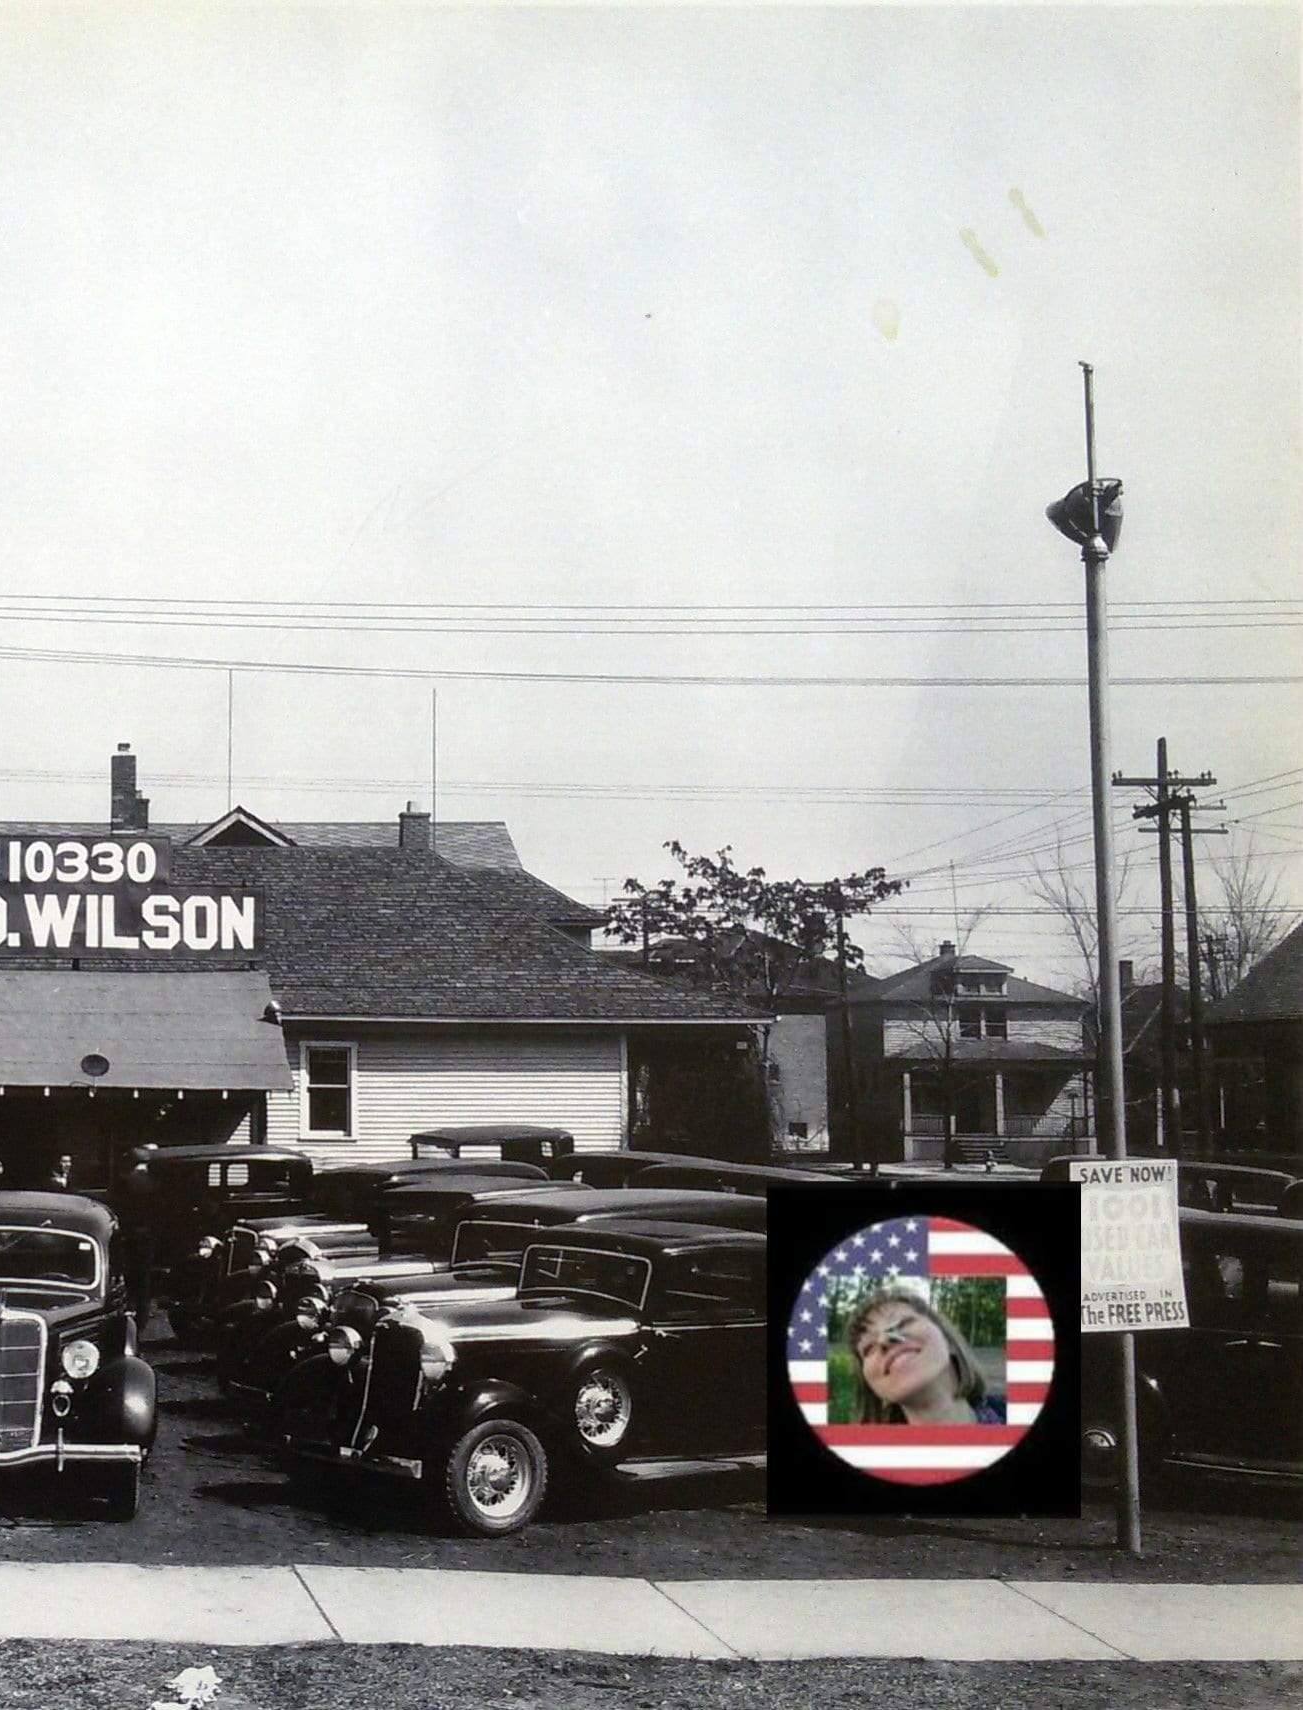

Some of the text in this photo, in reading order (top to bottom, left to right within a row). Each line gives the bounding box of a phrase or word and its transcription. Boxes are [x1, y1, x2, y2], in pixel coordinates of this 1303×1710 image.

[8, 840, 157, 883] 10330
[1080, 1165, 1172, 1185] SAVE NOW!
[1082, 1289, 1173, 1302] ADVERTISED IN
[1108, 1303, 1143, 1324] FREE
[1145, 1301, 1185, 1322] PRESS
